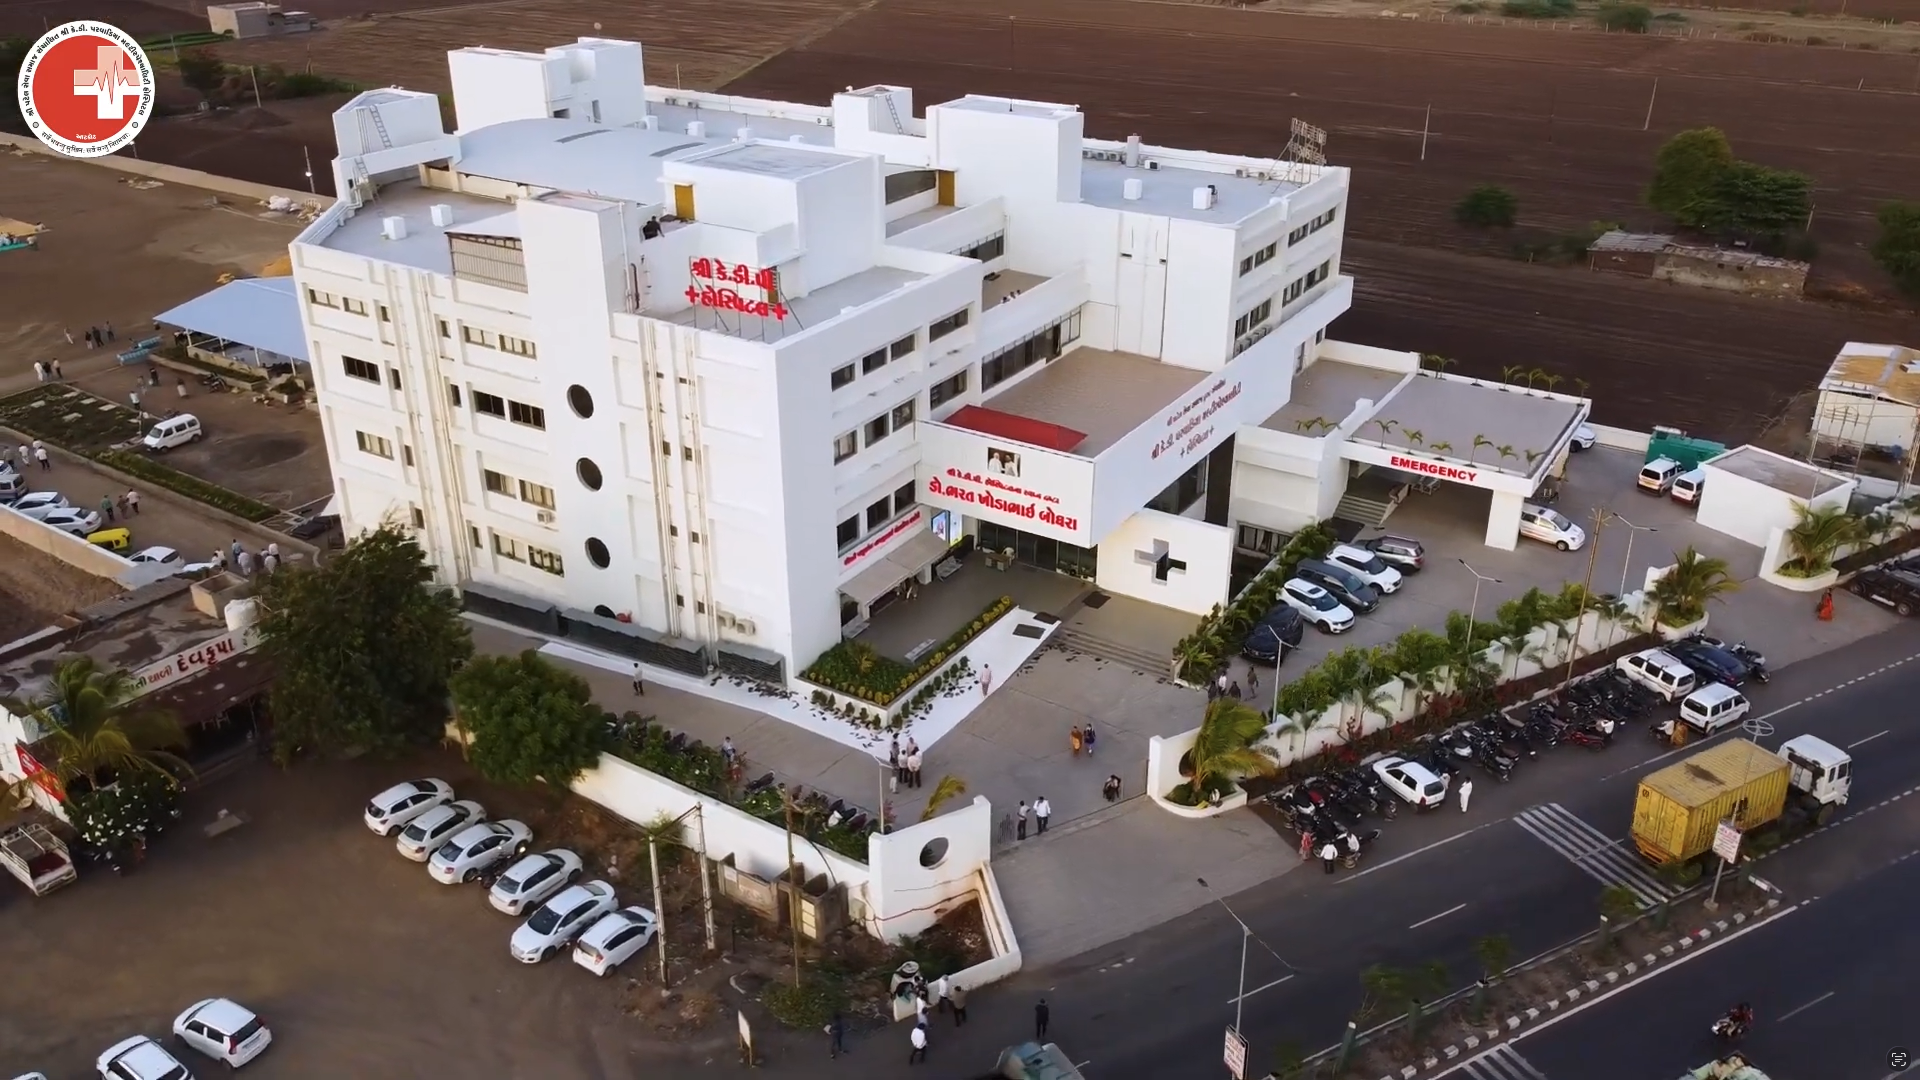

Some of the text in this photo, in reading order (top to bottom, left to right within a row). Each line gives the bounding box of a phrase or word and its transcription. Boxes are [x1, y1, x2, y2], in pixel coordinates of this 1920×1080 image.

[691, 257, 712, 279] શ્રી
[701, 284, 769, 317] હોસ્પિટલ
[1390, 456, 1478, 482] EMERGENCY
